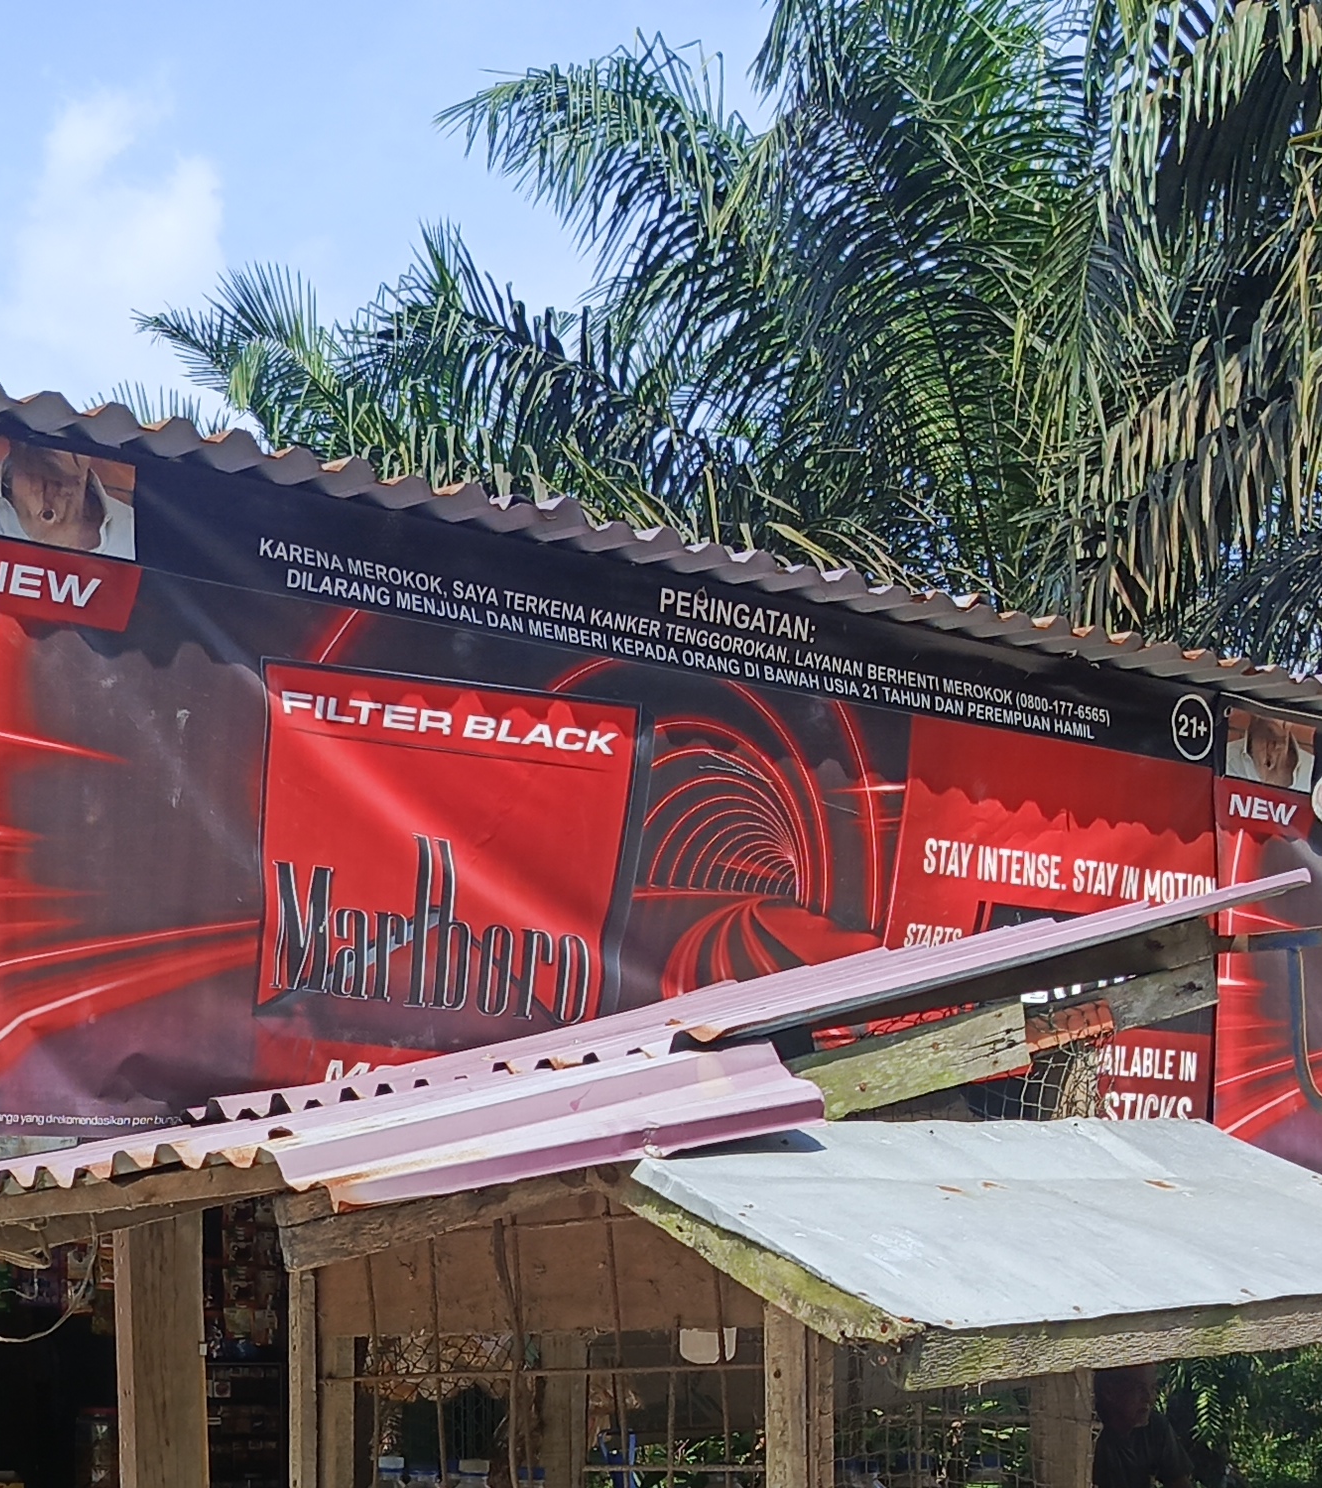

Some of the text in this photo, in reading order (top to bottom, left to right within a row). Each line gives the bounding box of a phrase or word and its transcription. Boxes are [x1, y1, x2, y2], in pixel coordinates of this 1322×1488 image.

[259, 537, 1111, 726] KARENA MEROKOK, SAYA TERKENA KANKER TENGGOROKAN. LAYANAN BERHENTI MEROKOK (0800-177-6565)
[659, 587, 816, 643] PERINGATAN:
[286, 568, 1095, 740] DILARANG MENJUAL DAN MEMBERI KEPADA ORANG DI BAWAH USIA 21 TAHUN DAN PEREMPUAN HAMIL
[281, 690, 619, 757] FILTER BLACK
[1178, 717, 1208, 738] 21+
[1228, 793, 1298, 826] NEW
[923, 837, 973, 878] STAY
[977, 844, 1068, 892] INTENSE.
[1072, 858, 1119, 896] STAY
[1120, 867, 1140, 902] IN
[269, 832, 590, 1026] Marlboro
[1178, 1051, 1197, 1081] IN
